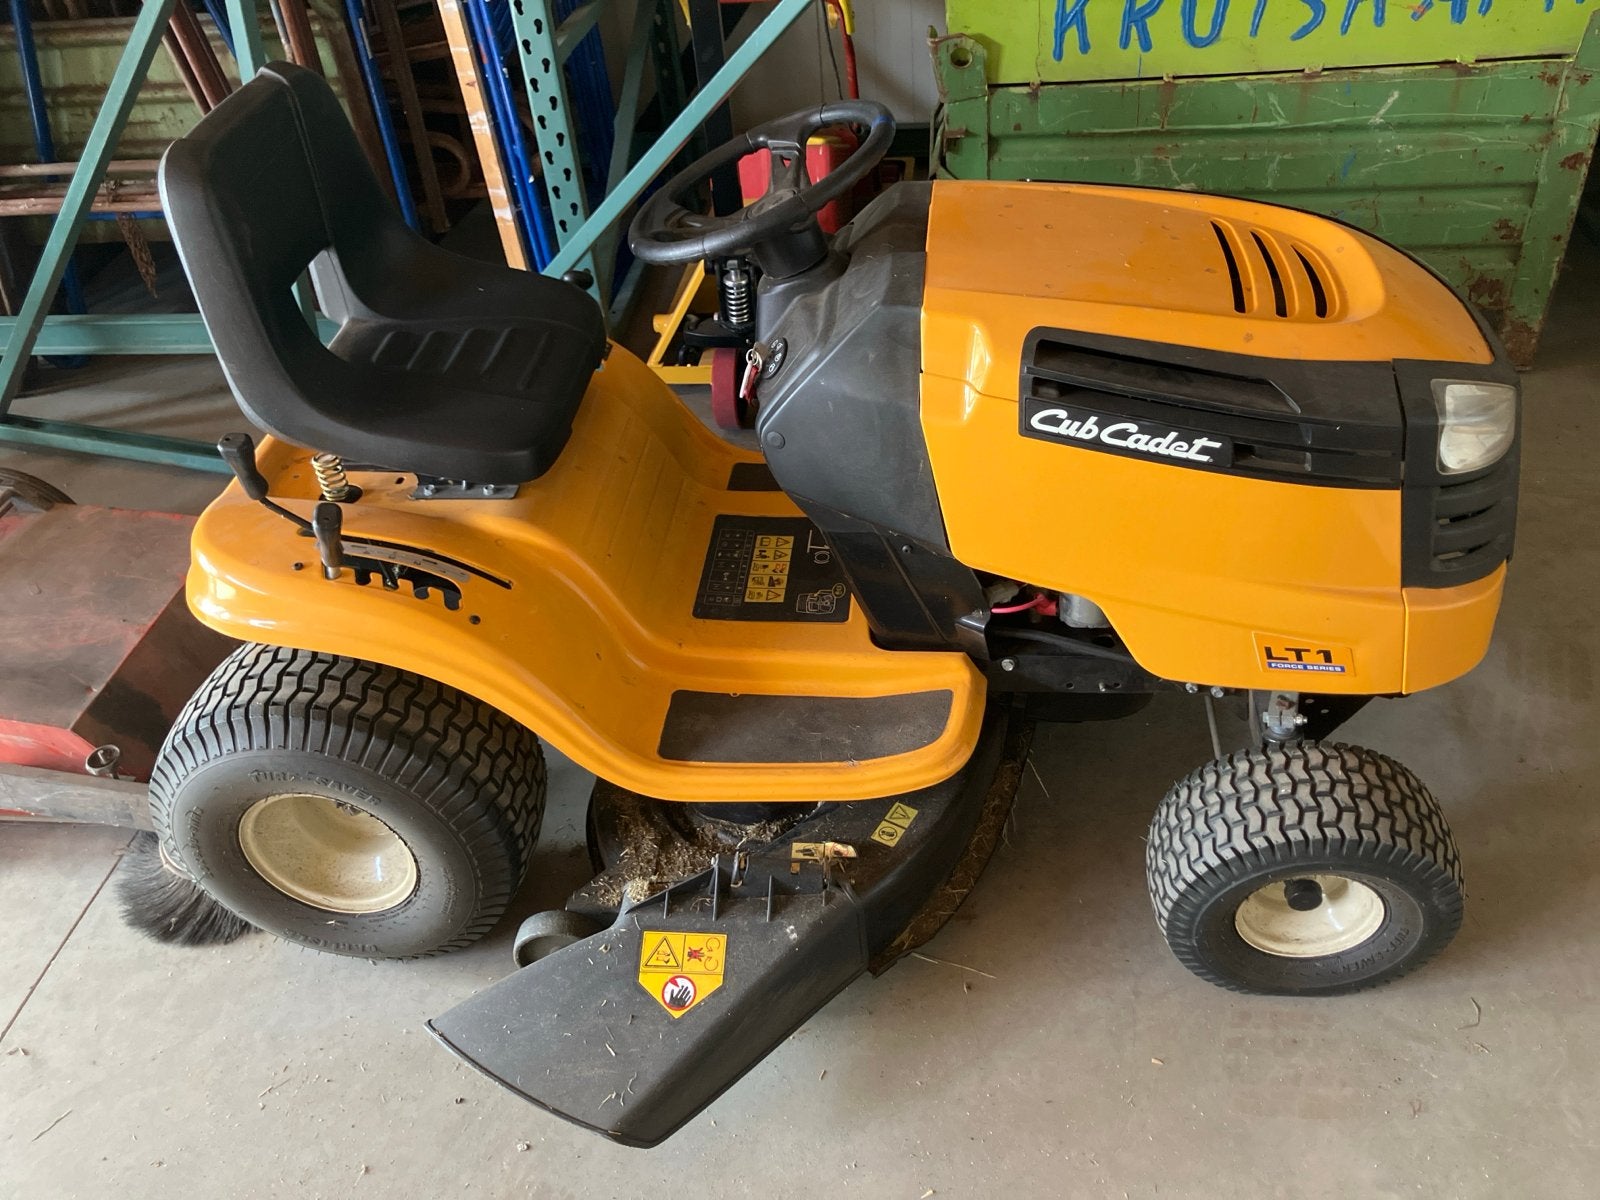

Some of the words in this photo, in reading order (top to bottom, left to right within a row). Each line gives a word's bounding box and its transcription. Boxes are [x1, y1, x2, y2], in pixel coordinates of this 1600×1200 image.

[1030, 409, 1099, 440] Cub
[1100, 422, 1222, 462] Cadet
[1264, 646, 1333, 663] LT1
[1271, 662, 1304, 670] FORCE
[1306, 664, 1342, 672] SERIES
